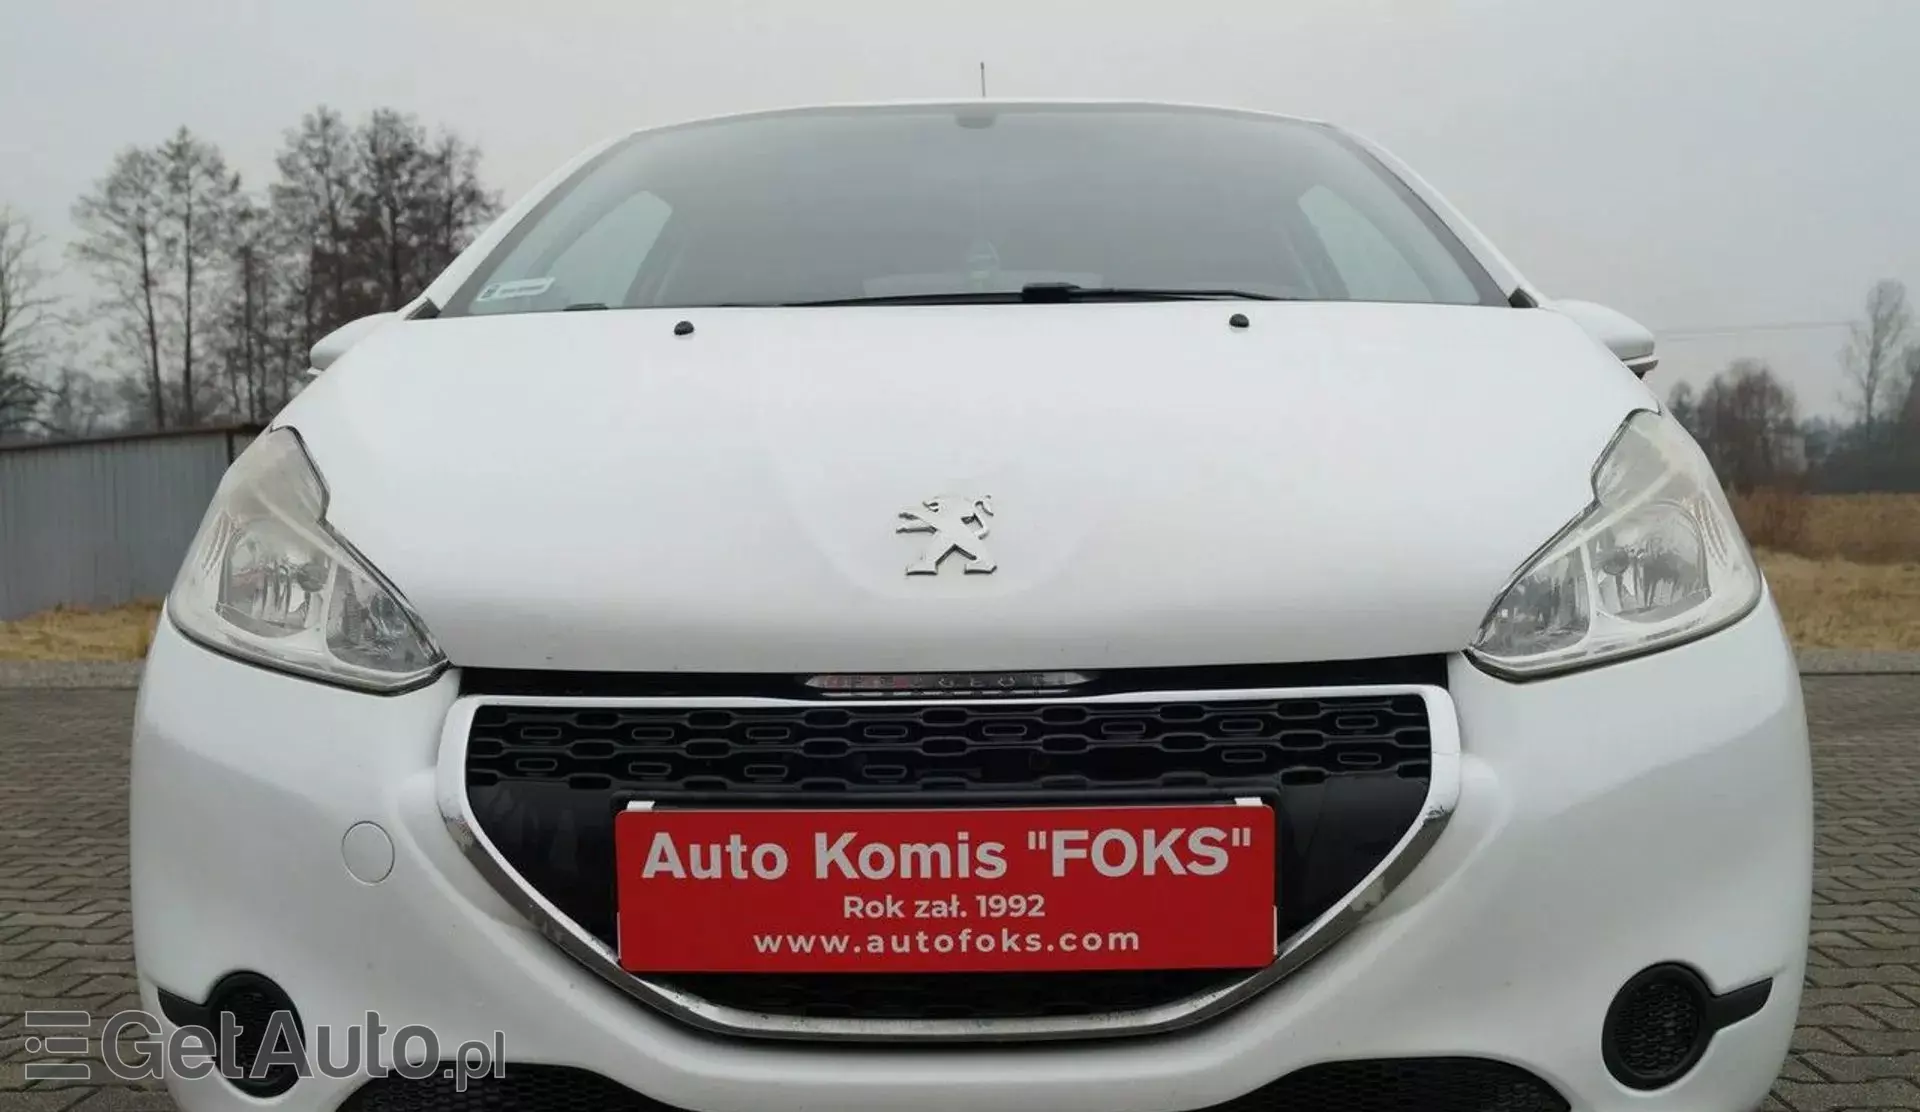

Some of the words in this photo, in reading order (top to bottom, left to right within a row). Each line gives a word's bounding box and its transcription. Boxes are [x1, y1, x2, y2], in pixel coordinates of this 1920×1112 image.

[642, 832, 788, 880] Auto
[815, 831, 1007, 879] Komis
[1028, 827, 1250, 877] "FOKS"
[844, 895, 904, 918] Rok
[915, 895, 967, 918] zał.
[976, 894, 1045, 917] 1992
[754, 928, 1139, 953] www.autofoks.com
